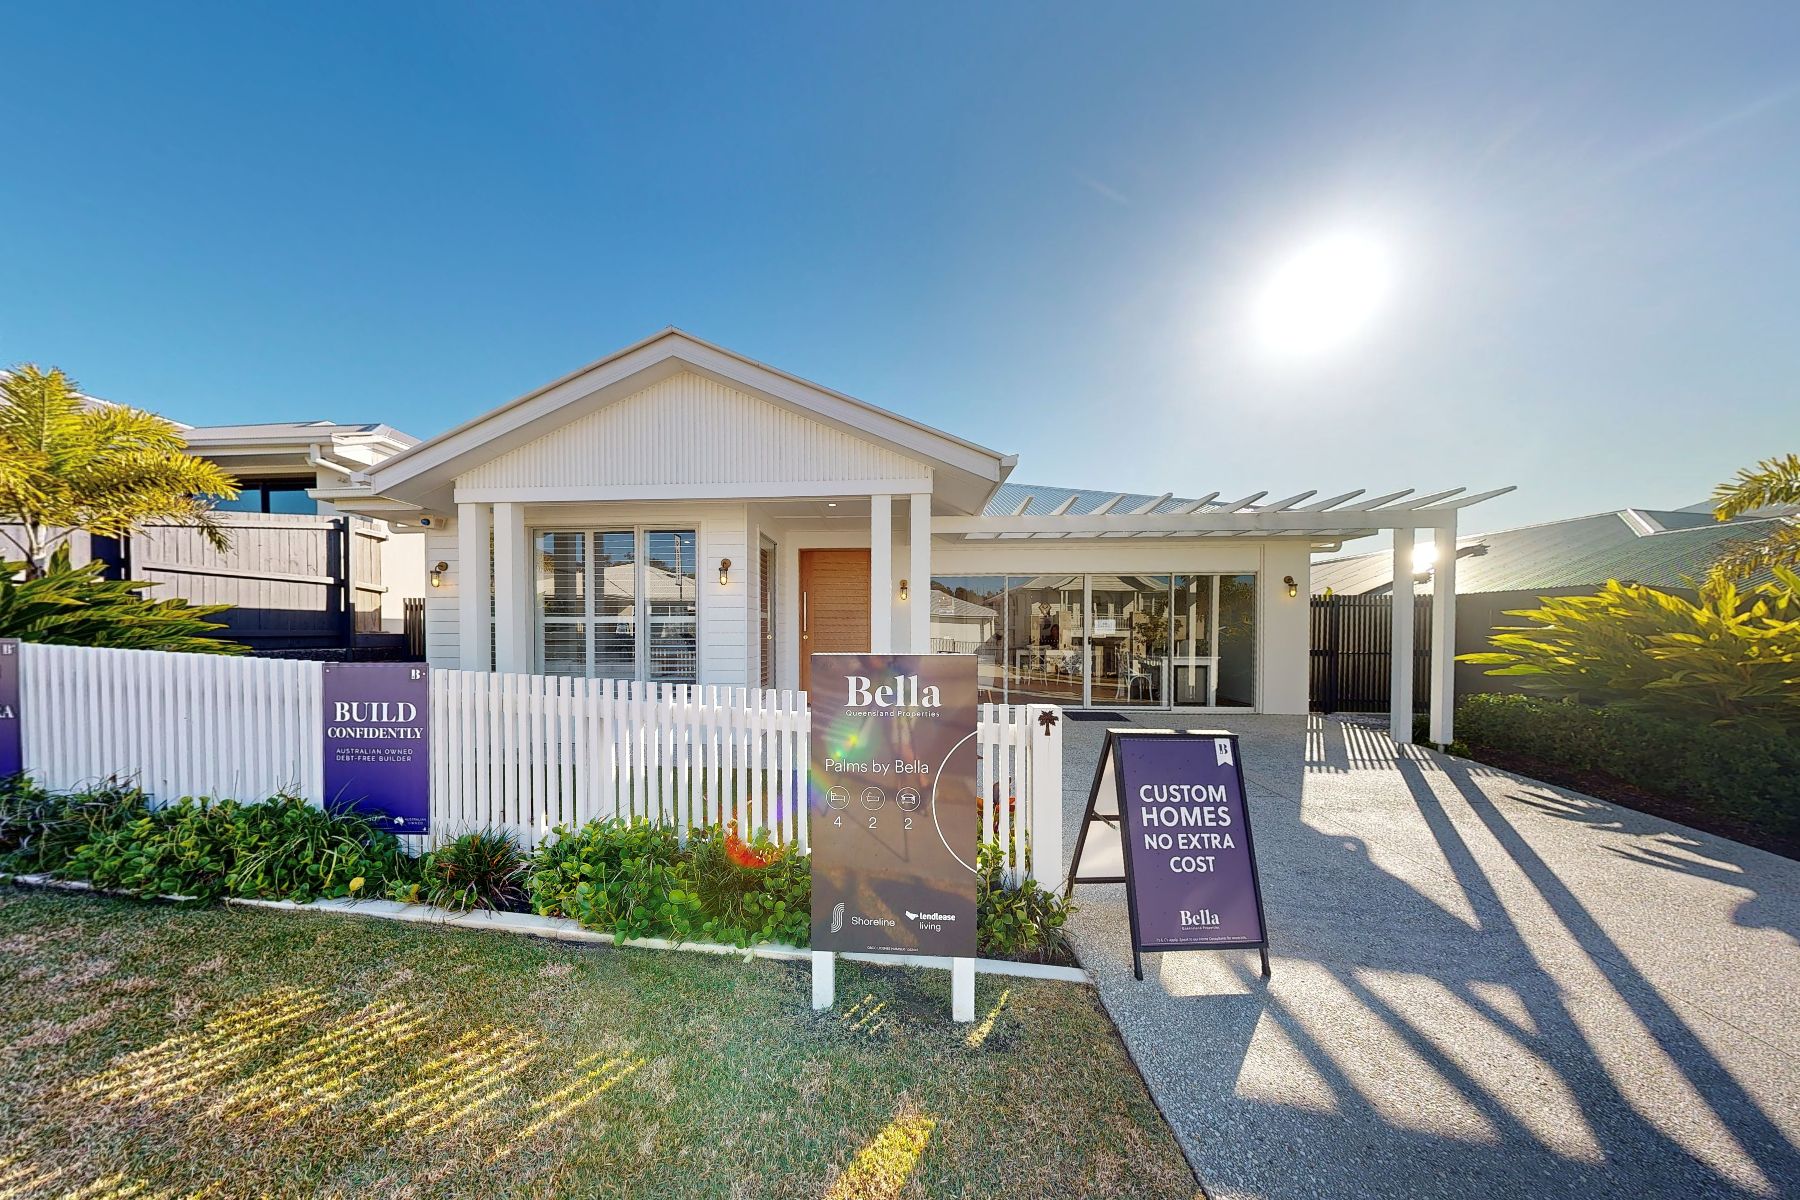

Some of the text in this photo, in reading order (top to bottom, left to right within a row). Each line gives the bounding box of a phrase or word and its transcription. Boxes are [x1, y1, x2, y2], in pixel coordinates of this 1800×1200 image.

[844, 674, 942, 708] Bella
[334, 701, 417, 722] BUILD
[845, 709, 940, 718] Queensland Properties
[327, 726, 423, 739] CONFIDENTLY
[825, 758, 929, 776] Palms by Bella
[1139, 784, 1227, 803] CUSTOM
[833, 816, 913, 830] 4 2 2
[1141, 806, 1231, 827] HOMES
[1144, 833, 1235, 850] NO EXTRA
[1169, 856, 1215, 873] COST
[851, 916, 896, 927] Shoreline
[919, 912, 956, 921] lendlease
[1179, 909, 1220, 926] Bella
[919, 921, 942, 932] living
